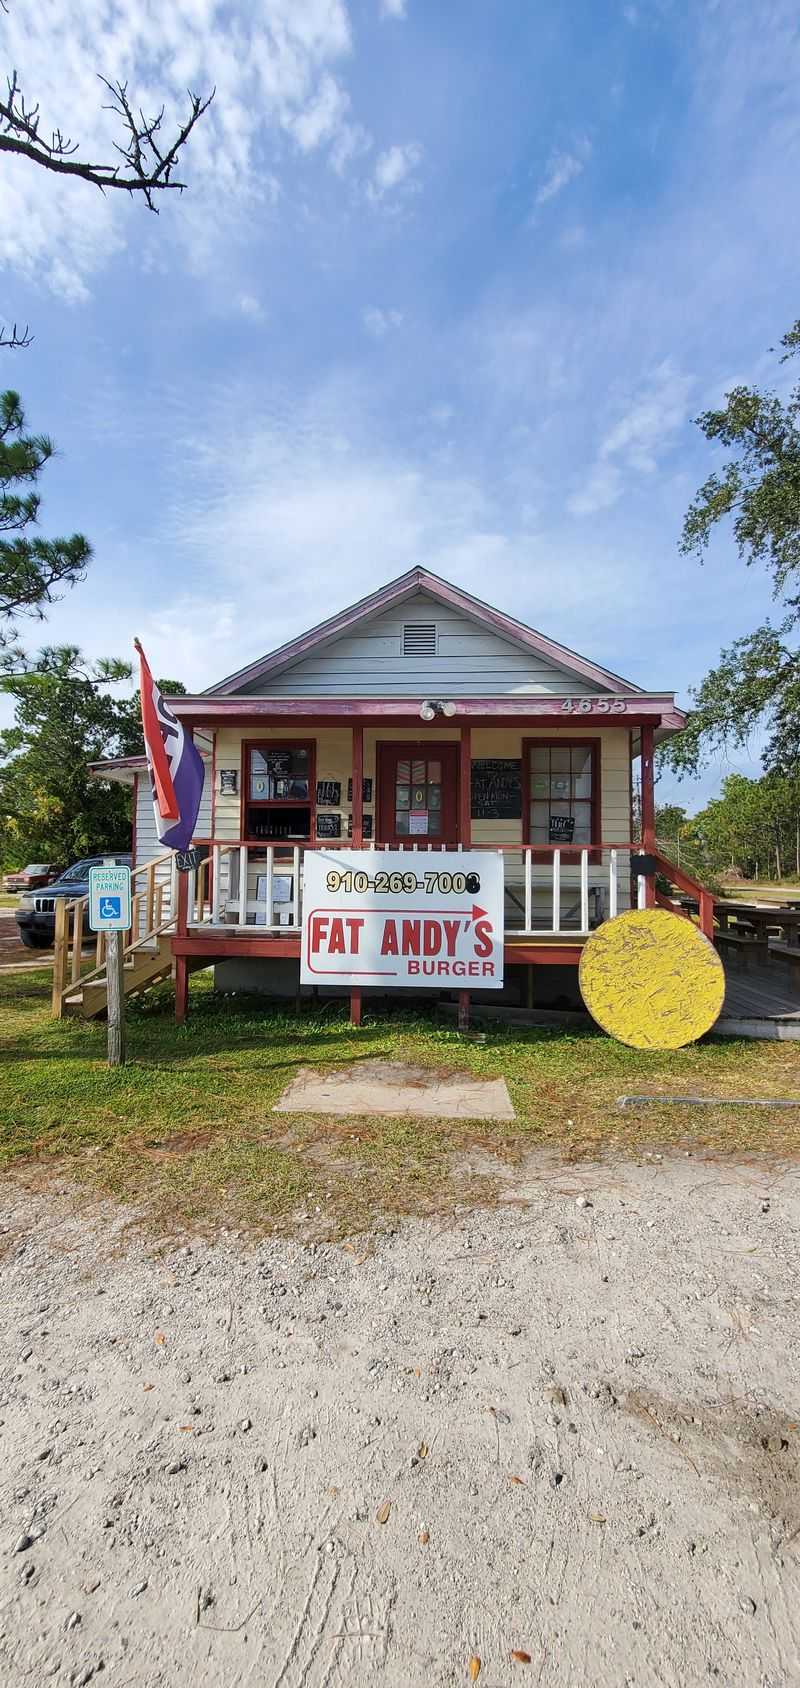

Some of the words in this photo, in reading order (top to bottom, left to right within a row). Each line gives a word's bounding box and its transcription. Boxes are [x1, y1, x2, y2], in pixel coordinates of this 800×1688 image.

[560, 698, 628, 714] 4655
[176, 850, 200, 868] EXIT
[93, 872, 127, 881] RESERVED
[96, 882, 124, 891] PARKING
[311, 917, 365, 955] FAT
[380, 918, 494, 958] ANDY'S
[407, 960, 495, 976] BURGER
